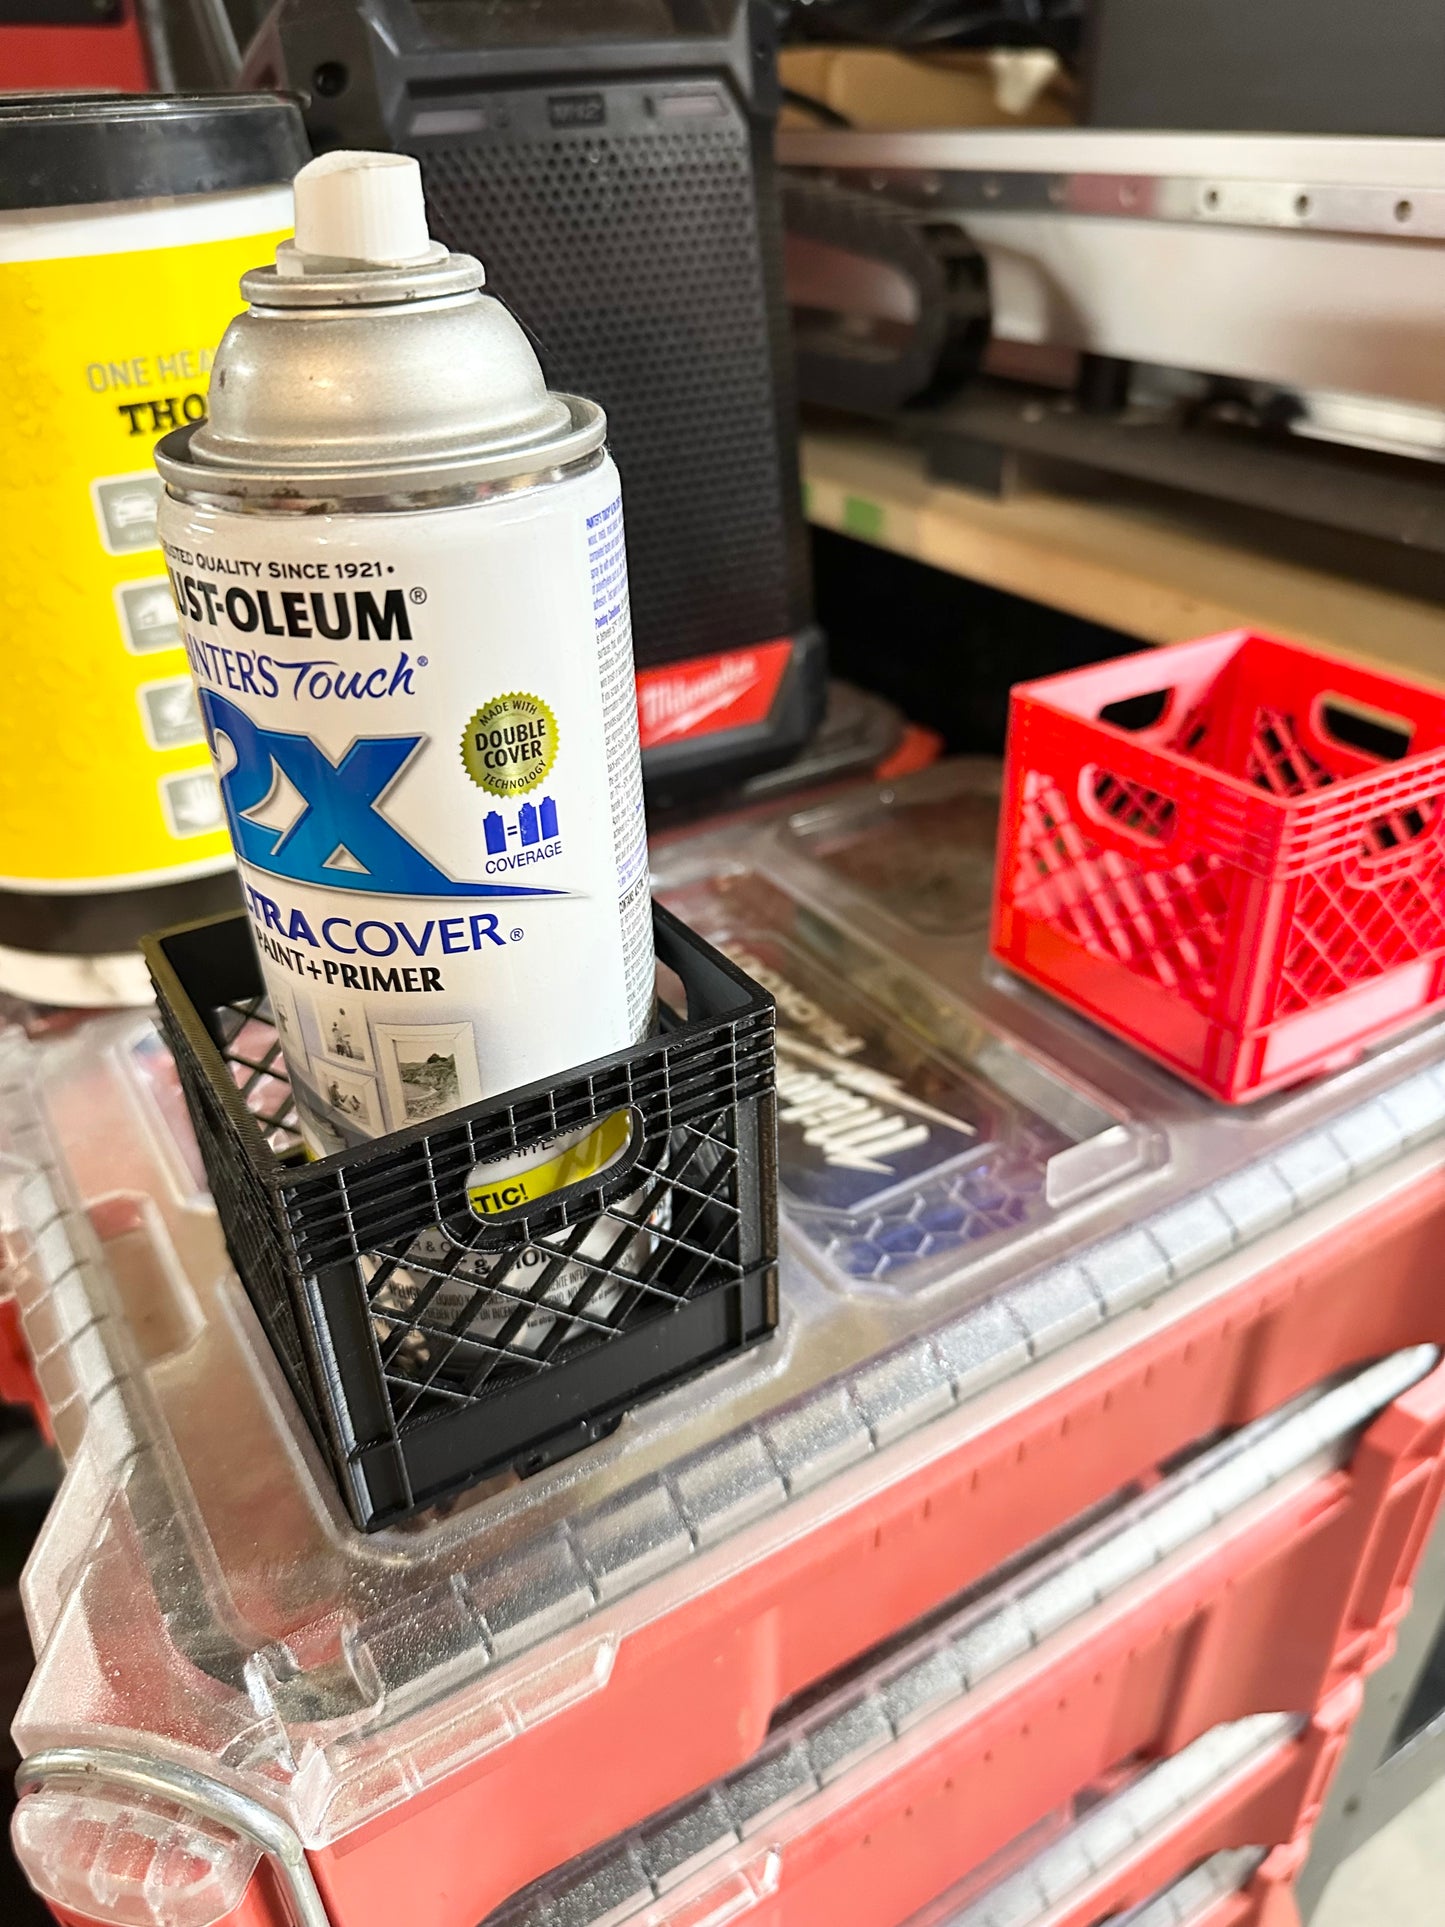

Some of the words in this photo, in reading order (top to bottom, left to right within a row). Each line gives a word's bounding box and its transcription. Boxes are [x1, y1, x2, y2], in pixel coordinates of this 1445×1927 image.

[86, 357, 151, 393] ONE
[118, 394, 206, 437] THO
[196, 552, 261, 578] QUALITY
[269, 563, 330, 579] SINCE
[479, 701, 509, 727] MADE
[512, 700, 538, 715] WITH
[475, 718, 547, 752] DOUBLE
[483, 740, 543, 769] COVER
[483, 759, 547, 790] TECHNOLOGY
[199, 687, 450, 896] 2X
[485, 841, 563, 874] COVERAGE
[245, 882, 321, 948] TRA
[466, 1182, 529, 1214] TIC!
